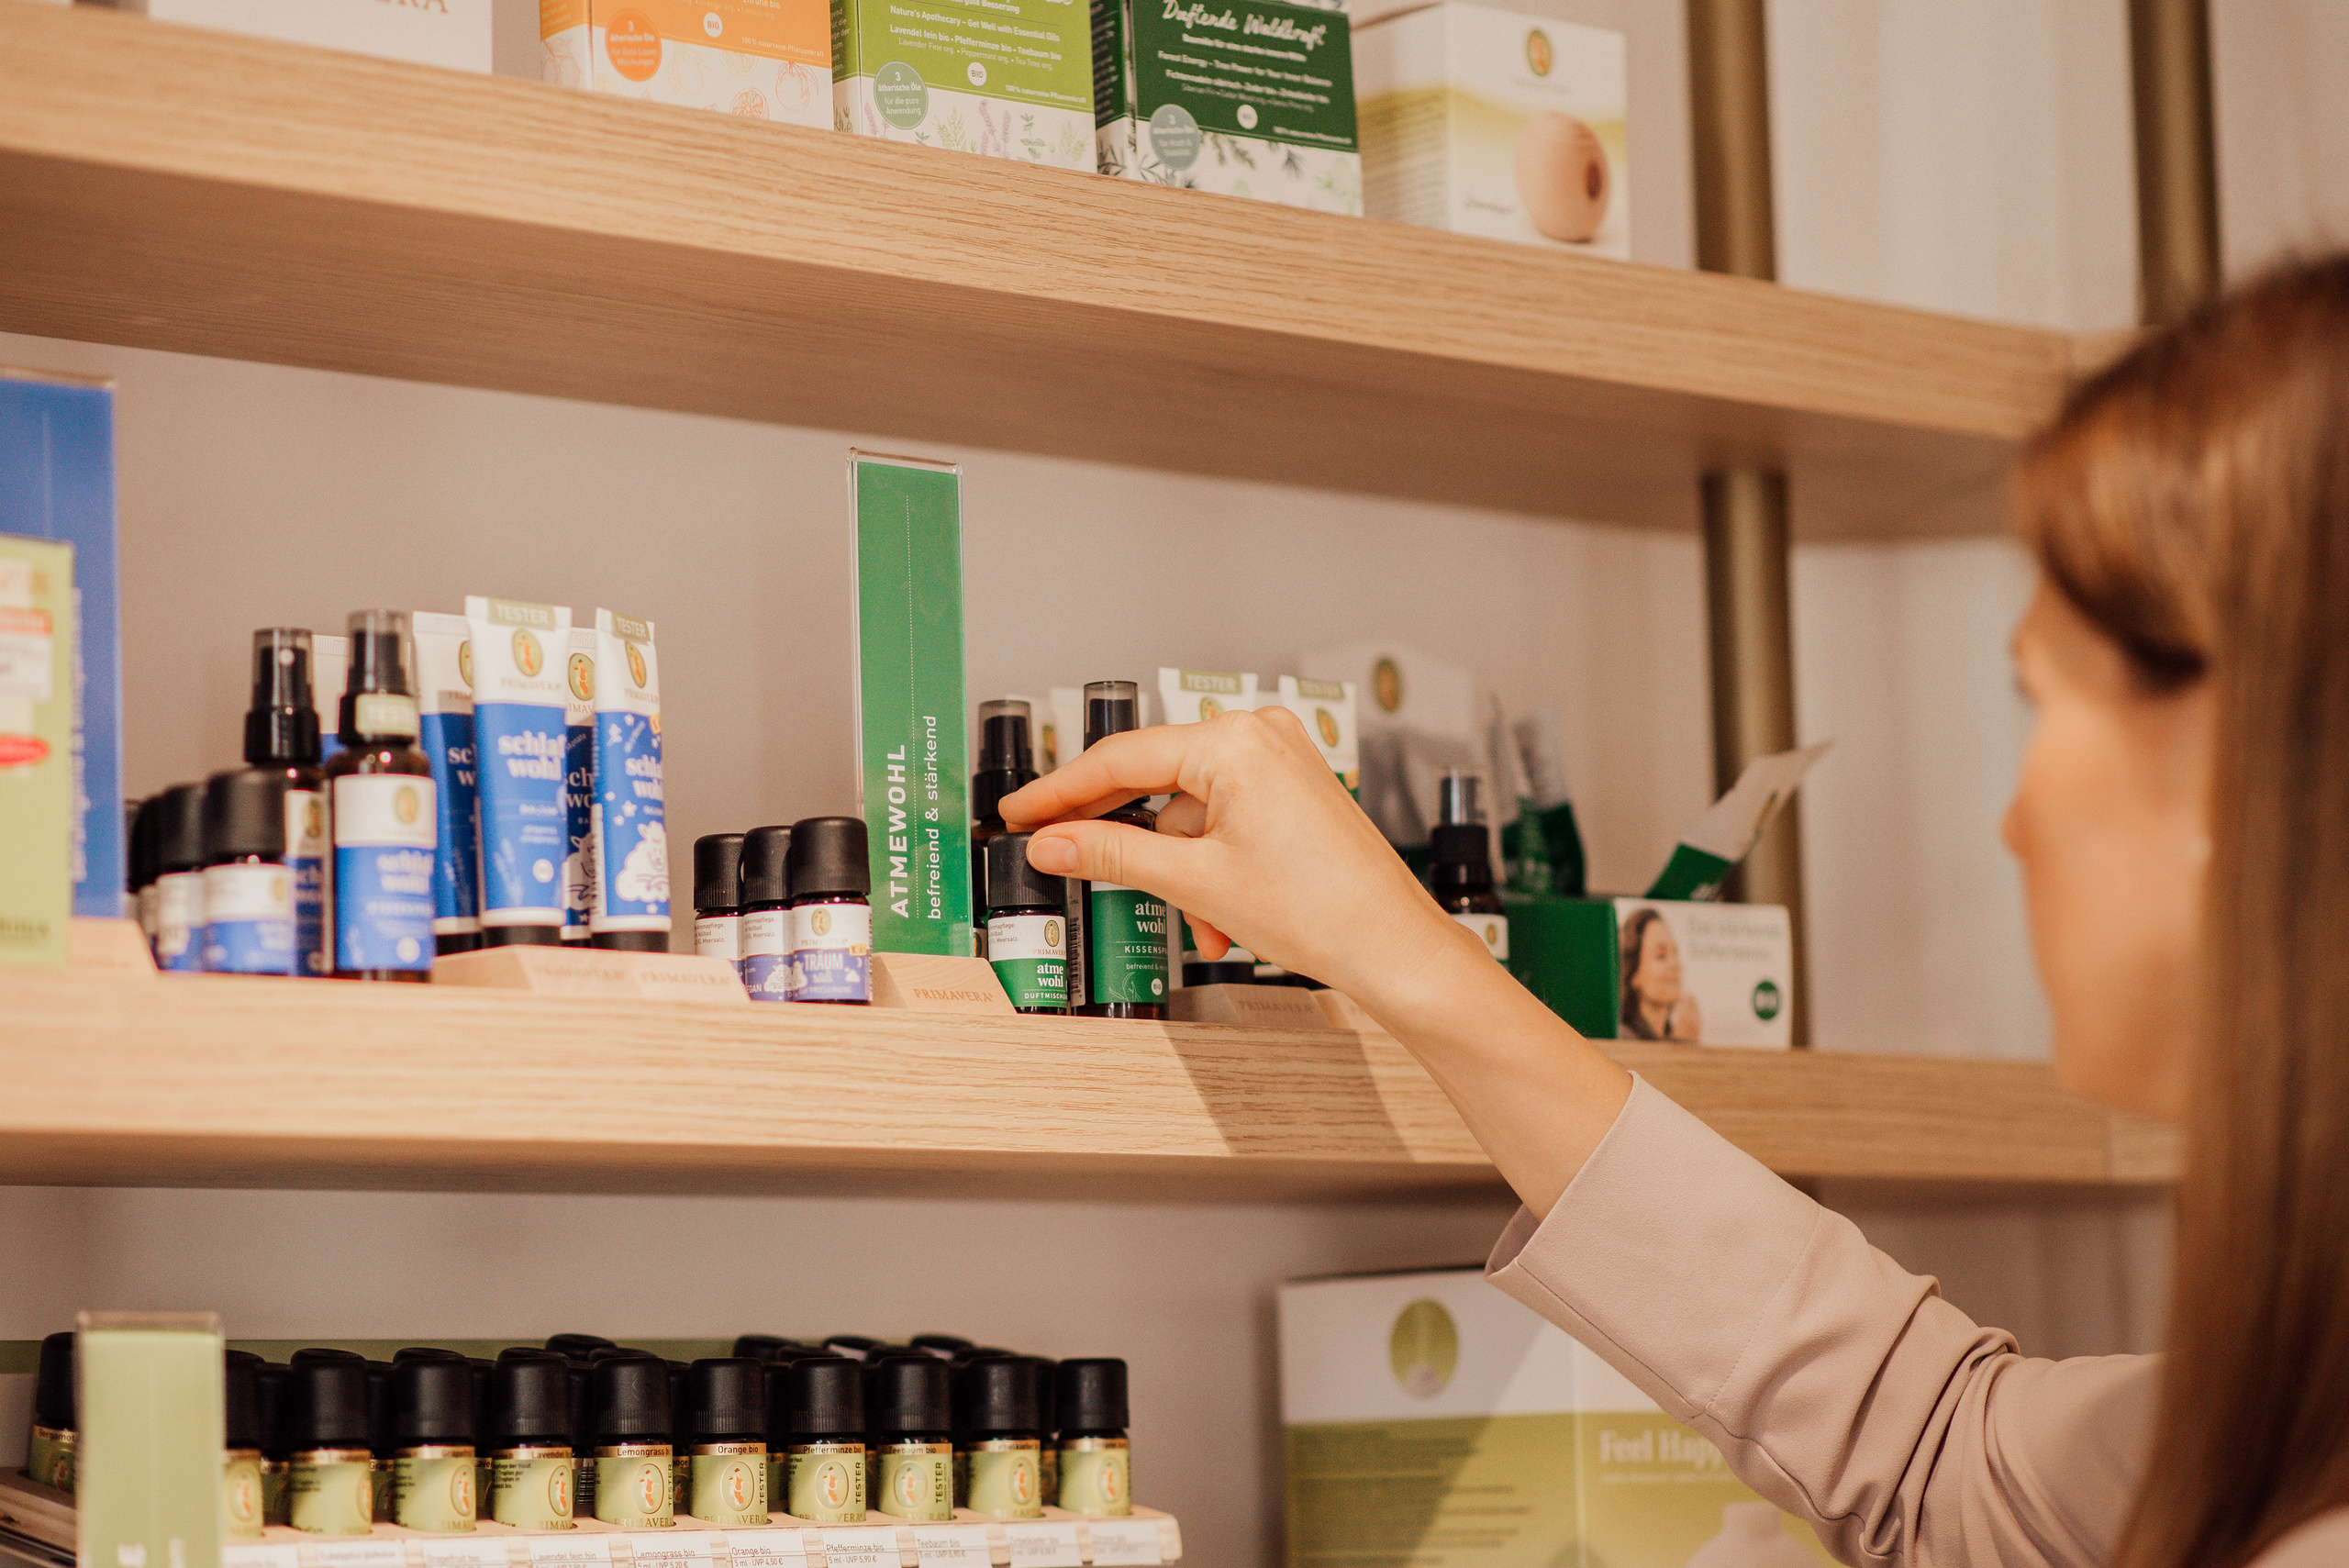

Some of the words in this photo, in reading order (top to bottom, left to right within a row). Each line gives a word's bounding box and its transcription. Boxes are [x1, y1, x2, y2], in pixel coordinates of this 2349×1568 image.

[707, 20, 719, 29] BIO
[890, 6, 920, 18] Nature's
[921, 11, 962, 27] Apothecary
[967, 18, 980, 28] Get
[981, 21, 996, 31] Well
[890, 24, 923, 38] Lavendel
[938, 32, 950, 42] bio
[1001, 43, 1012, 52] bio
[895, 72, 901, 81] 3
[971, 70, 984, 79] BIO
[495, 605, 550, 625] TESTER
[616, 617, 647, 639] TESTER
[922, 716, 939, 801] stärkend
[925, 807, 939, 822] &
[886, 744, 909, 918] ATMEWOHL
[927, 828, 941, 919] befreiend
[1135, 900, 1166, 917] atme
[1136, 917, 1167, 934] wohl
[1037, 962, 1064, 974] atme
[1037, 975, 1064, 987] wohl
[38, 1428, 75, 1441] Bergamot
[617, 1447, 664, 1457] Lemongrass
[718, 1445, 748, 1455] Orange
[748, 1444, 759, 1453] bio
[803, 1445, 852, 1454] Pfefferminze
[888, 1445, 924, 1455] Teebaum
[925, 1445, 937, 1454] bio
[935, 1462, 943, 1504] TESTER
[731, 1546, 759, 1557] Orange
[761, 1545, 772, 1554] bio
[826, 1543, 872, 1553] Pfefferminze
[873, 1542, 885, 1551] bio
[636, 1550, 682, 1561] Lemongrass
[684, 1548, 696, 1557] bio
[859, 1555, 872, 1563] 5,90
[765, 1558, 778, 1567] 4,50
